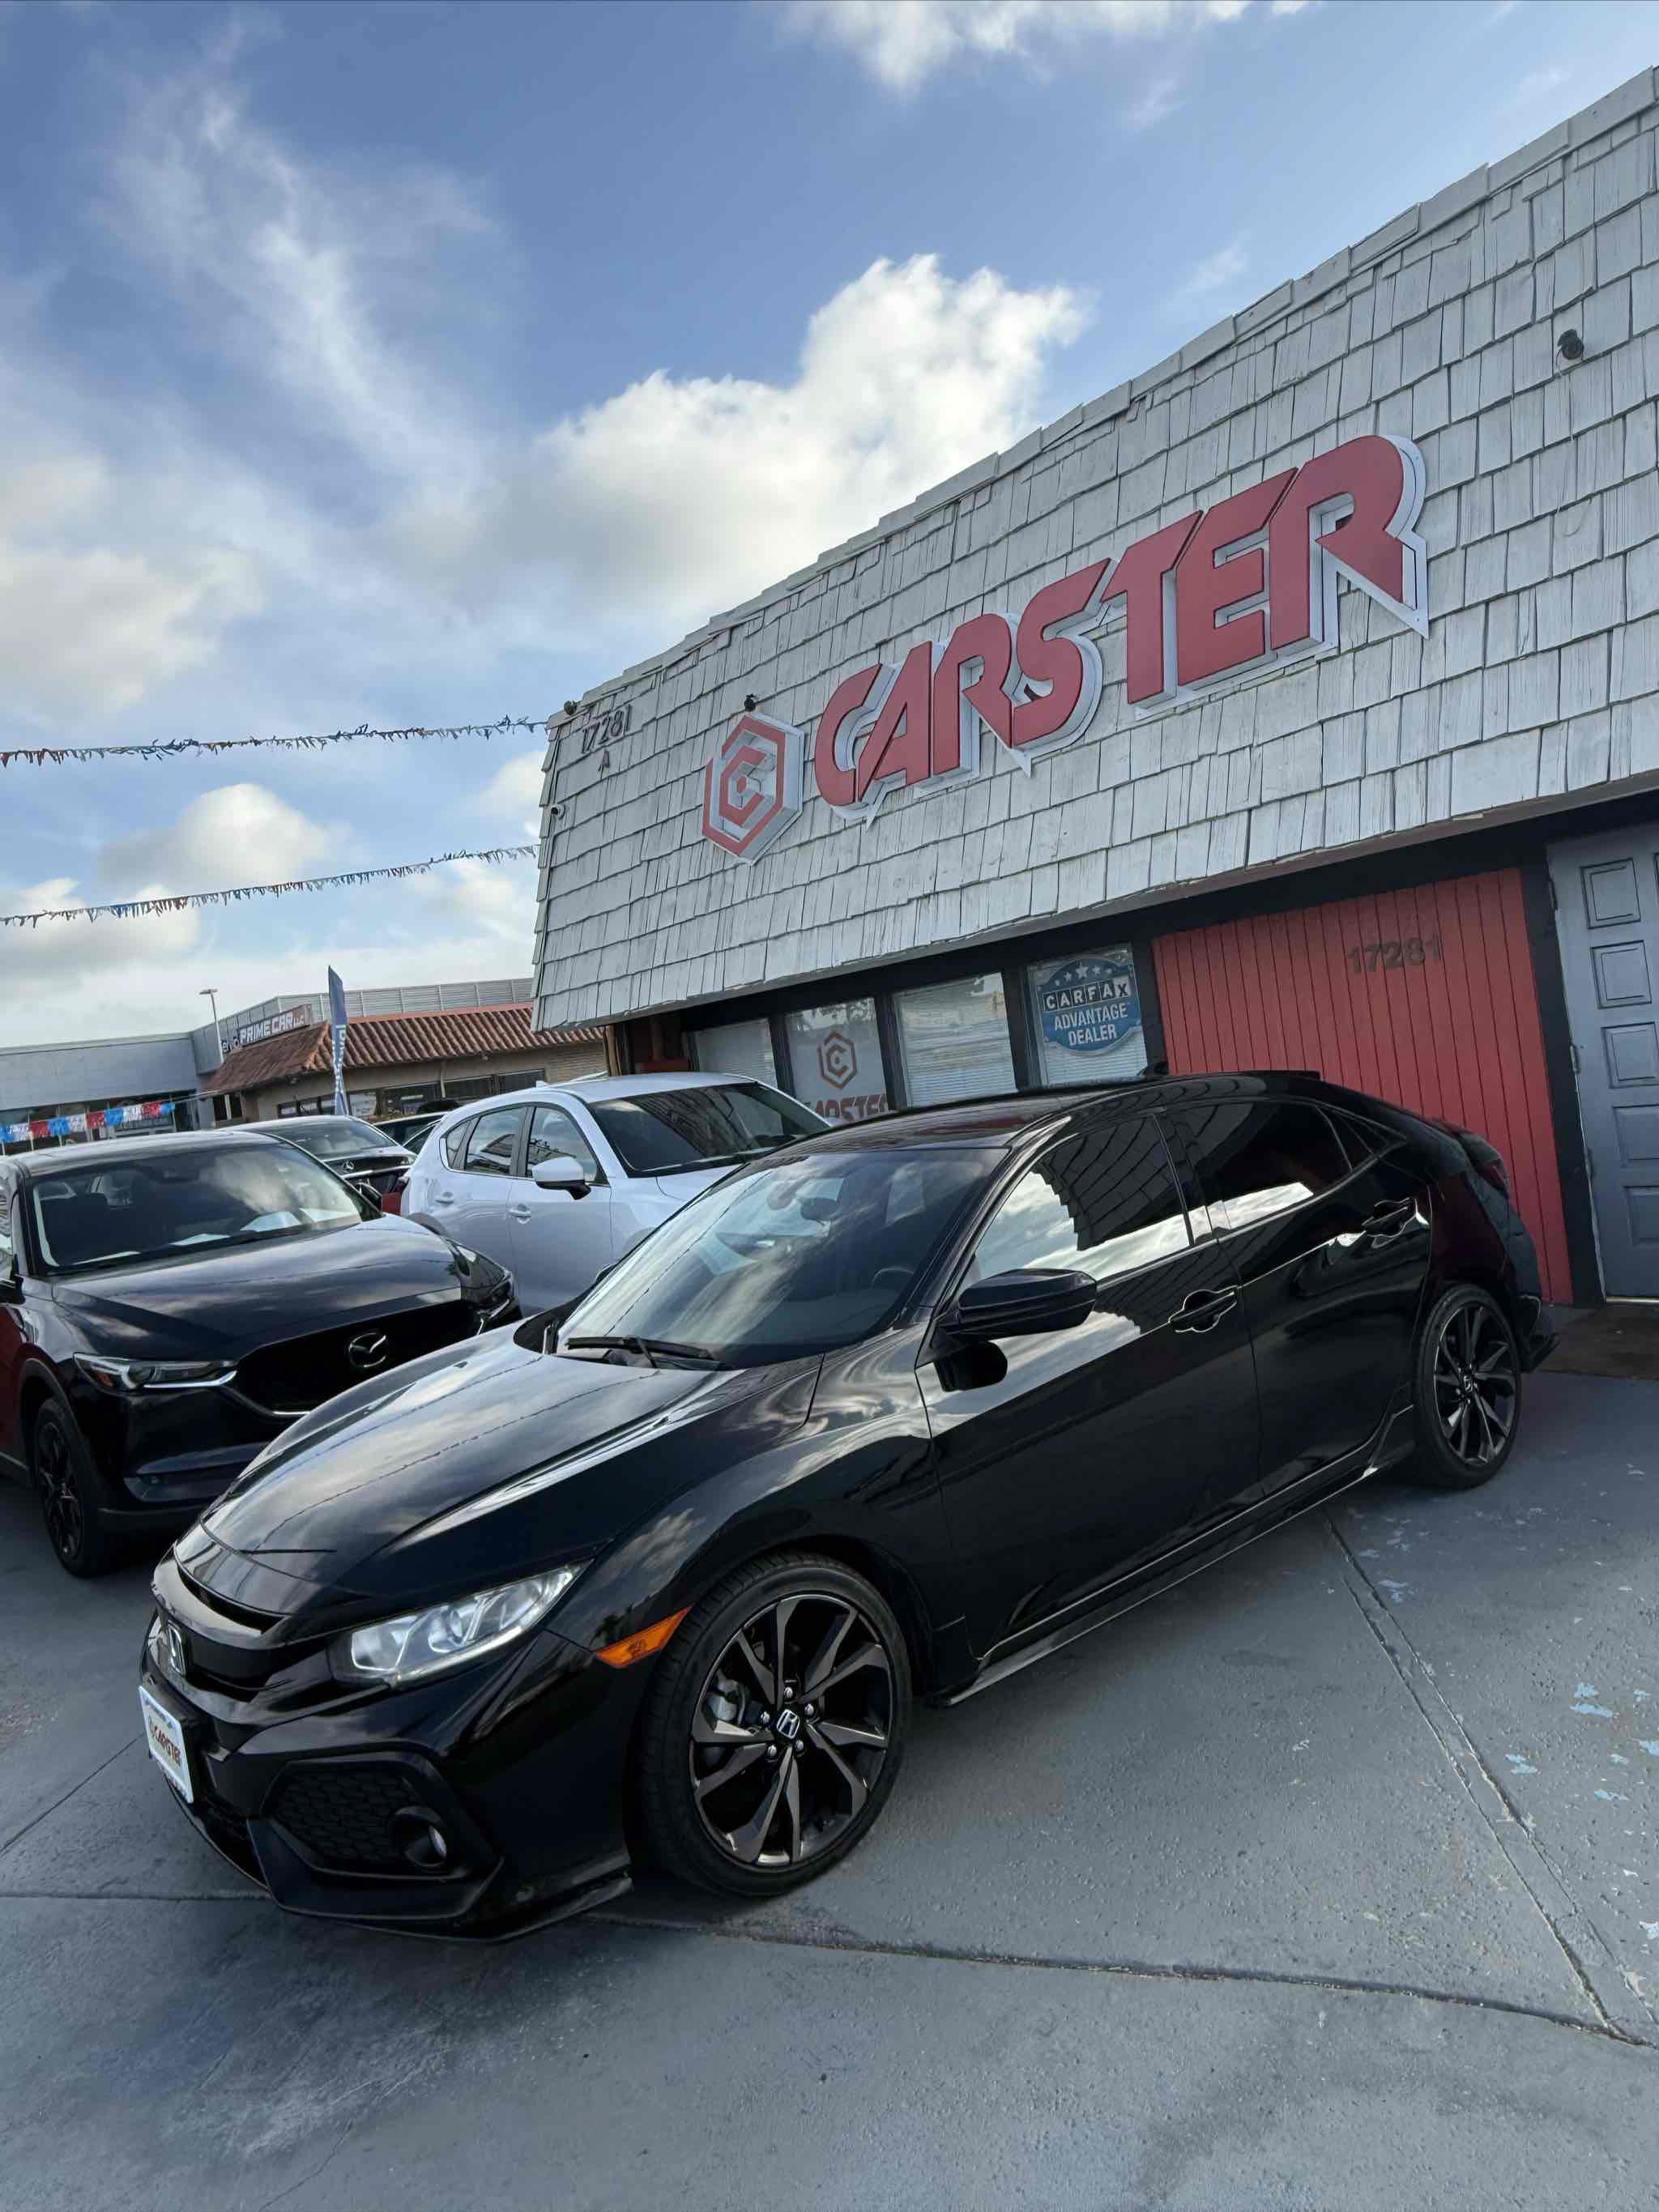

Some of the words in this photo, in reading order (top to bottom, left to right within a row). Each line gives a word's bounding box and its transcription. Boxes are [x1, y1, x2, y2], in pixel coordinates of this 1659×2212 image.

[814, 434, 1427, 822] CARSTER
[1348, 932, 1441, 973] 17281
[1044, 978, 1128, 1011] CARFAX
[239, 1018, 271, 1044] PRIME
[271, 1011, 293, 1034] CAR
[1055, 1002, 1128, 1030] ADVANTAGE
[1068, 1024, 1116, 1046] DEALER
